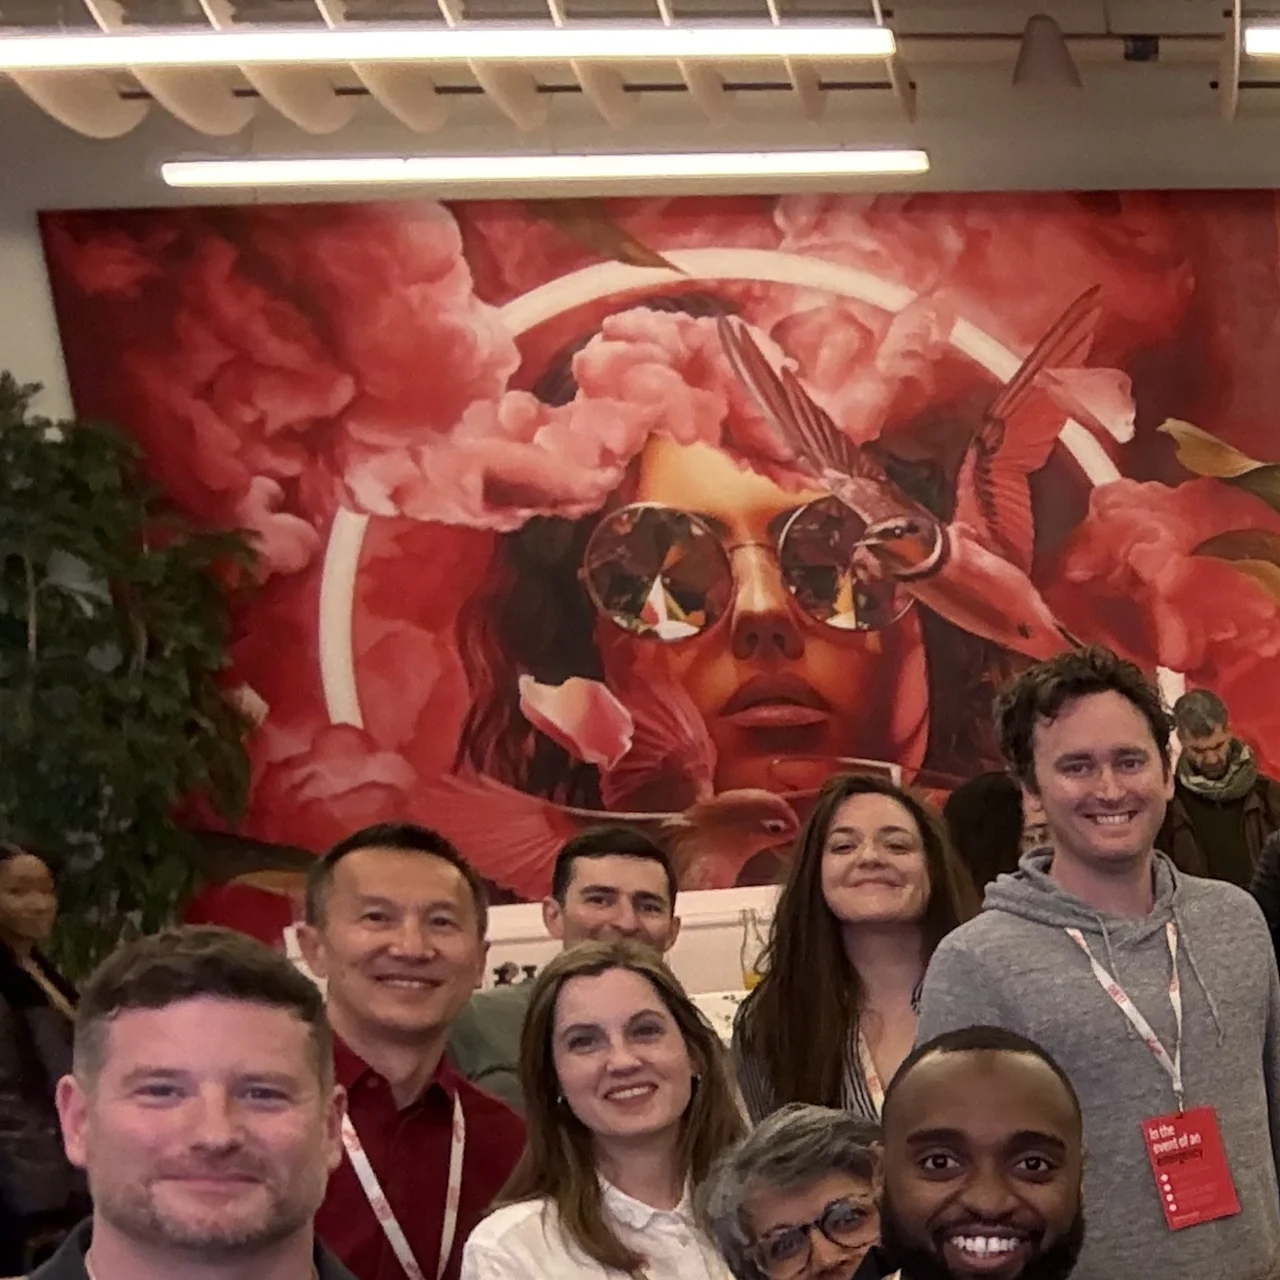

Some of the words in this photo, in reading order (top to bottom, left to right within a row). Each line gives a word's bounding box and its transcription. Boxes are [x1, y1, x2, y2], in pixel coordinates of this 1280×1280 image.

[1159, 1124, 1175, 1138] the
[1152, 1137, 1179, 1154] event
[1178, 1132, 1189, 1147] of
[1189, 1132, 1202, 1145] an
